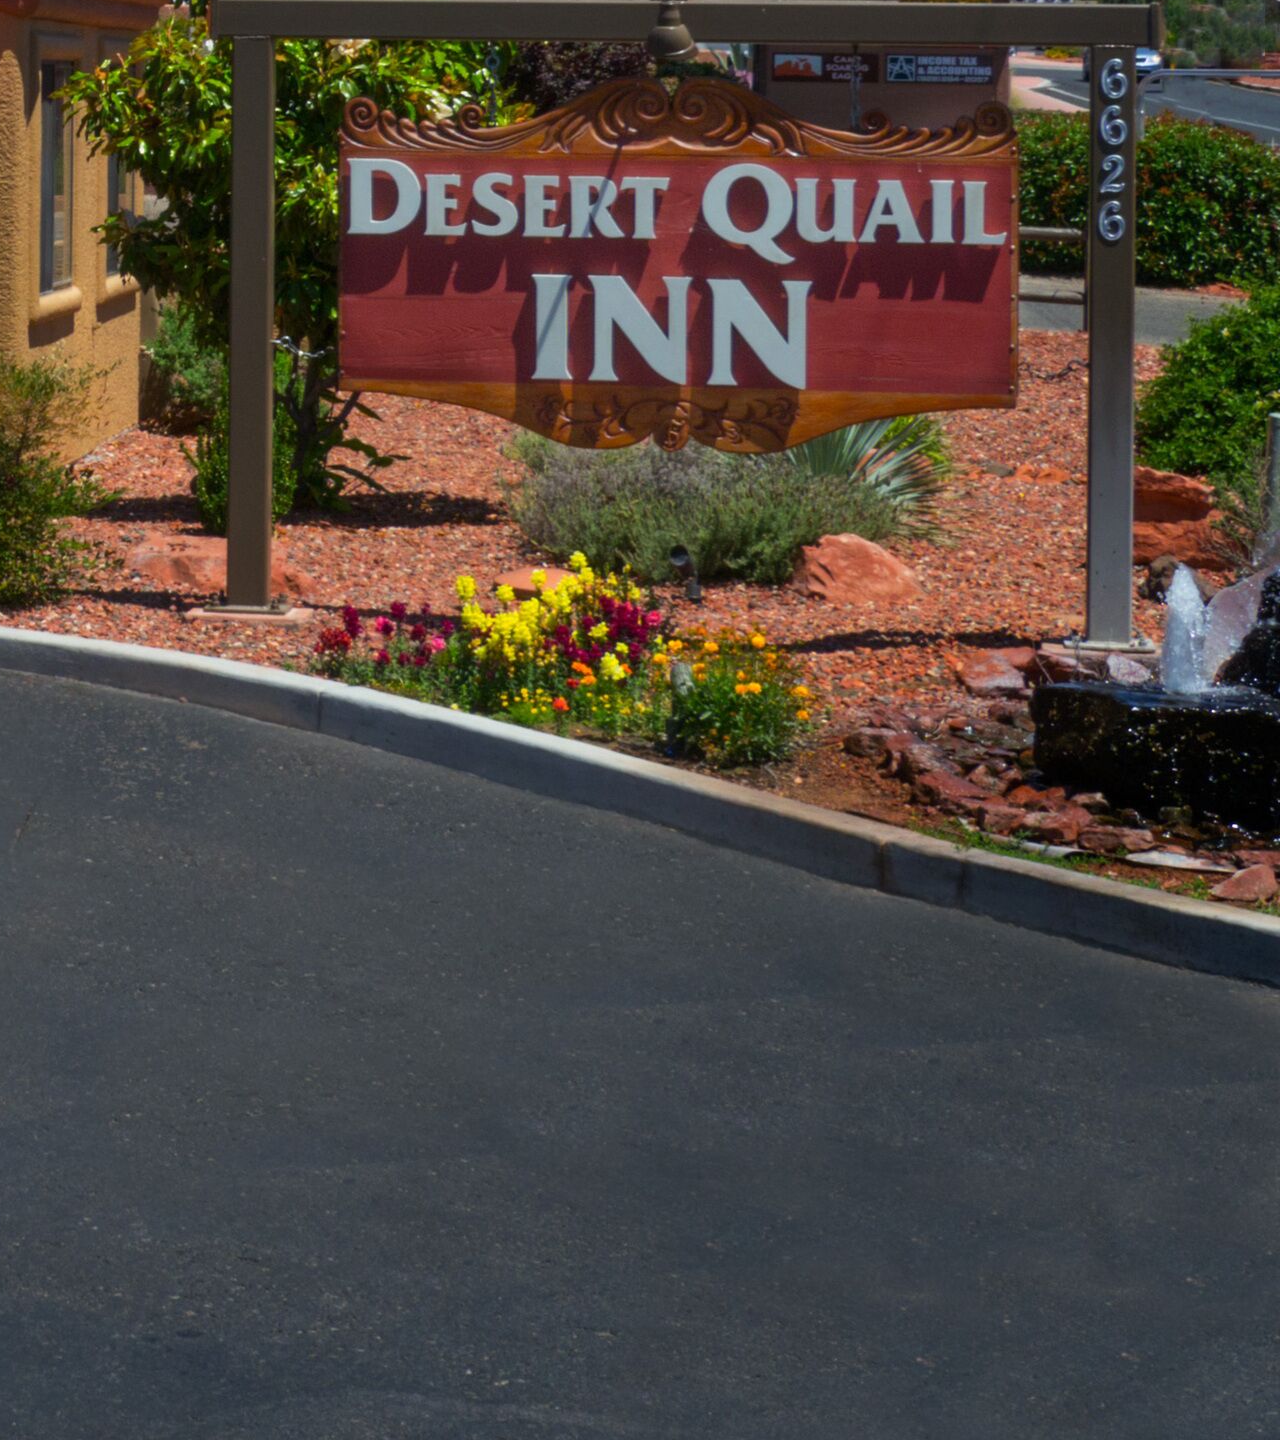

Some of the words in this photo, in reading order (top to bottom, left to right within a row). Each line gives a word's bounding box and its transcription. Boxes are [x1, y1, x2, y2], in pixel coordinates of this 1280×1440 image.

[1098, 58, 1128, 241] 6626
[346, 158, 671, 240] DESERT
[701, 163, 1007, 265] QUAIL
[531, 274, 814, 390] INN
